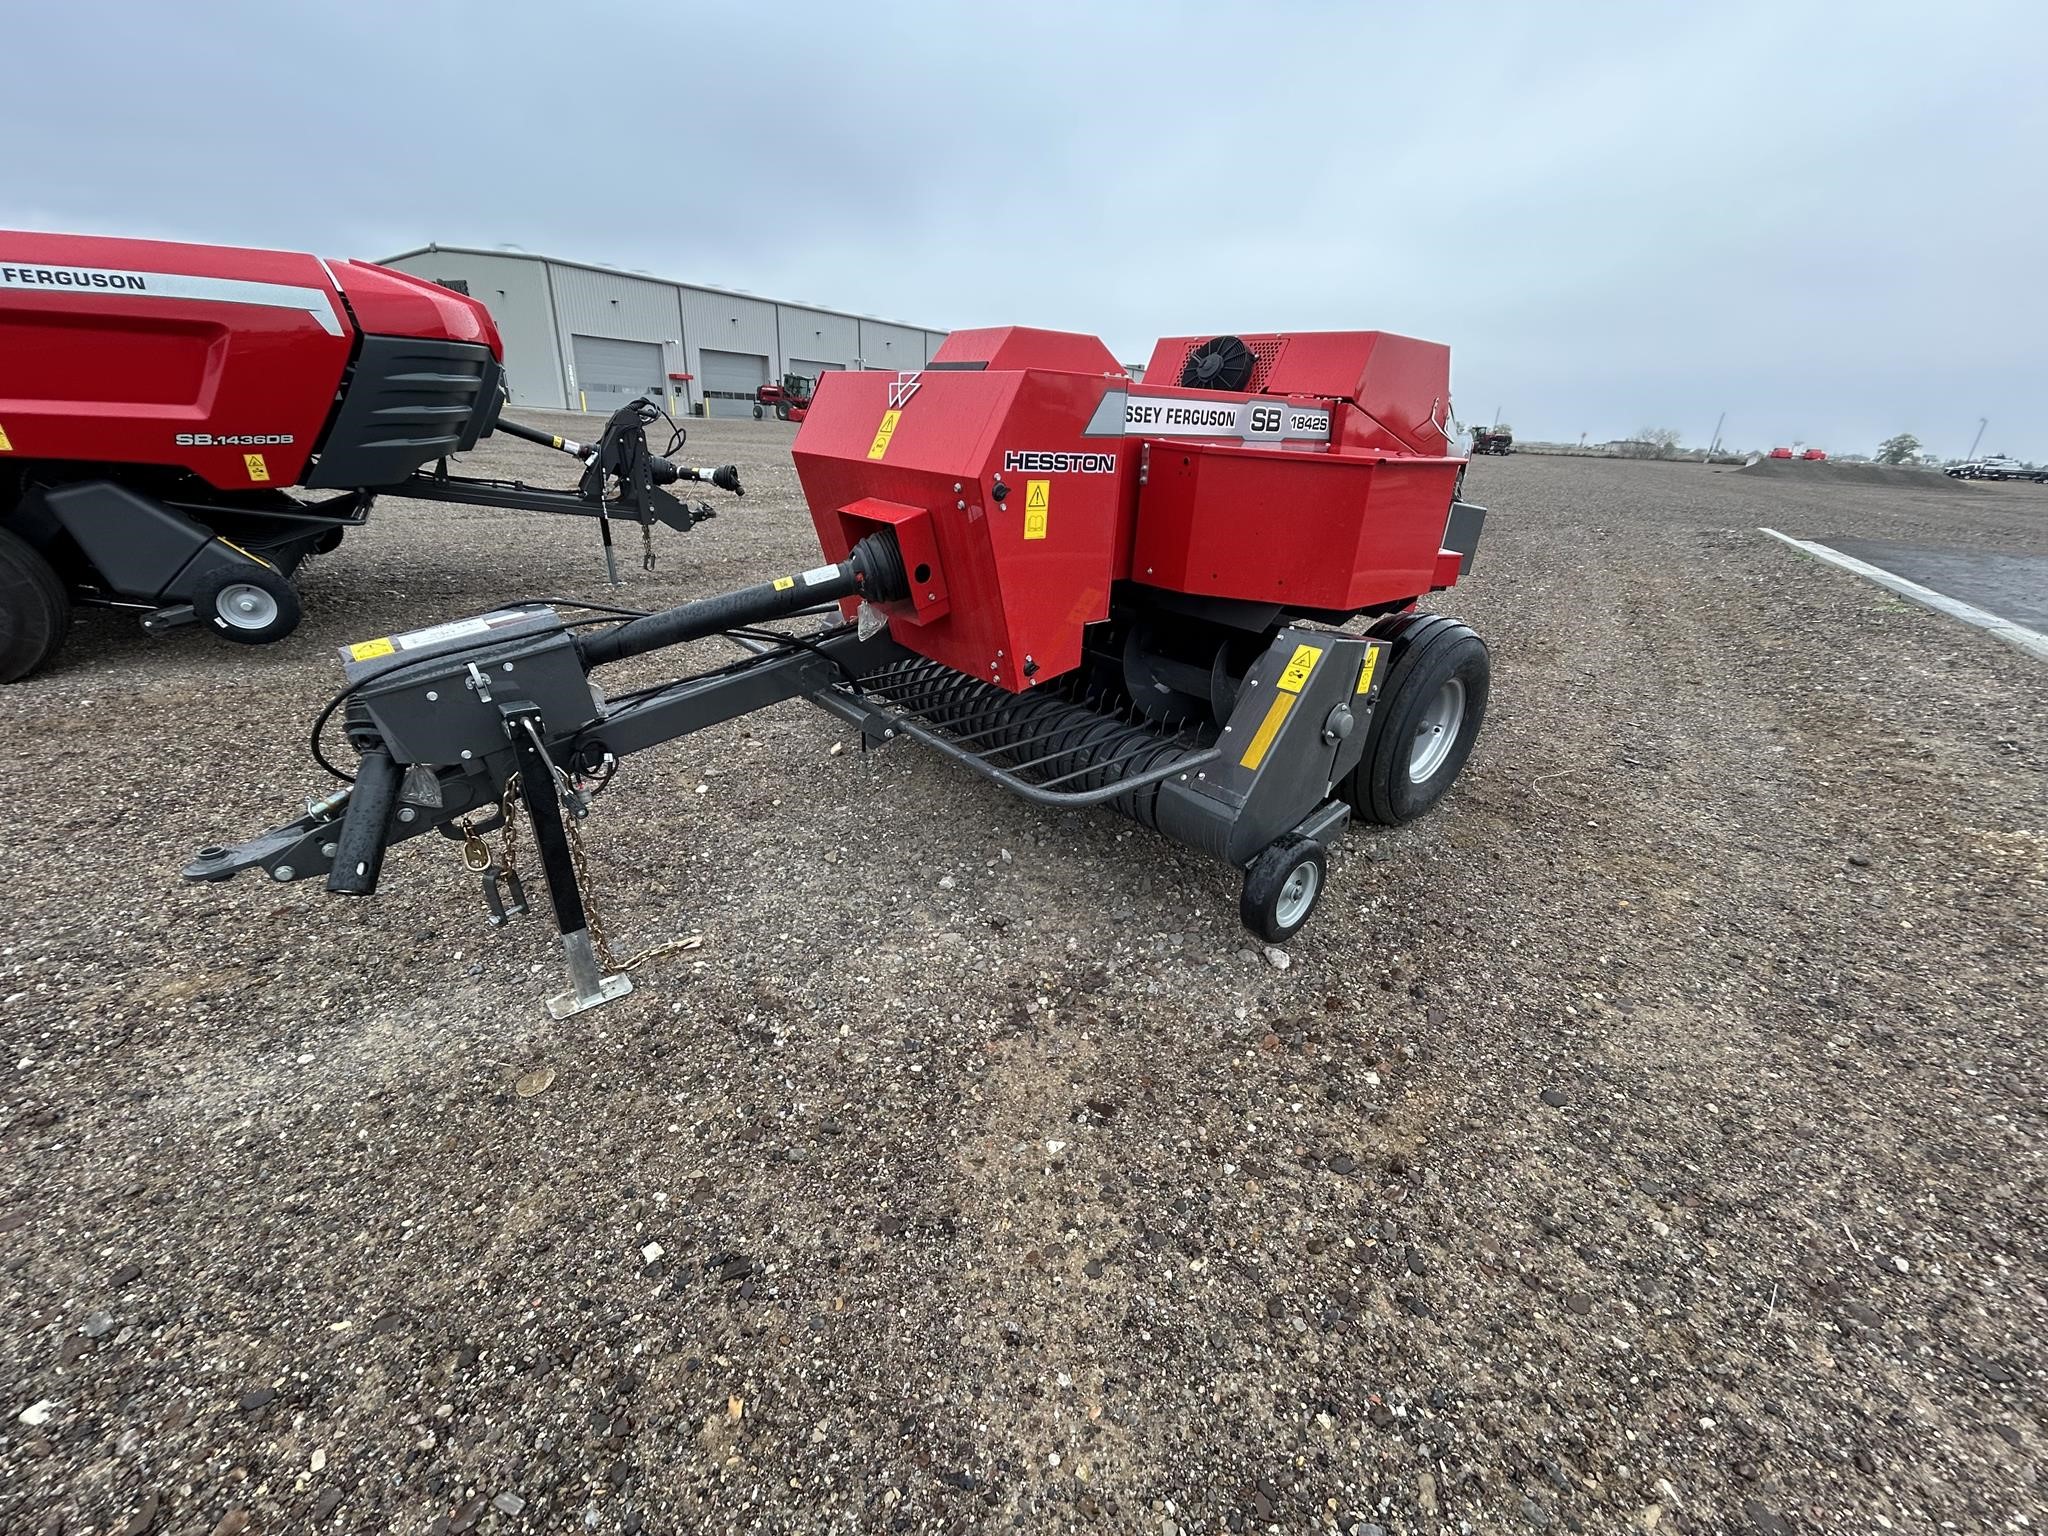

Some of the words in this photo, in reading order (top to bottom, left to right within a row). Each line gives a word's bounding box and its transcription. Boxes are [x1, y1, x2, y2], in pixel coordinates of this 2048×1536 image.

[2, 267, 147, 290] FERGUSON
[1166, 407, 1236, 427] FERGUSON
[1250, 407, 1282, 432] SB
[1290, 415, 1328, 431] 1842S
[1004, 451, 1115, 472] HESSTON
